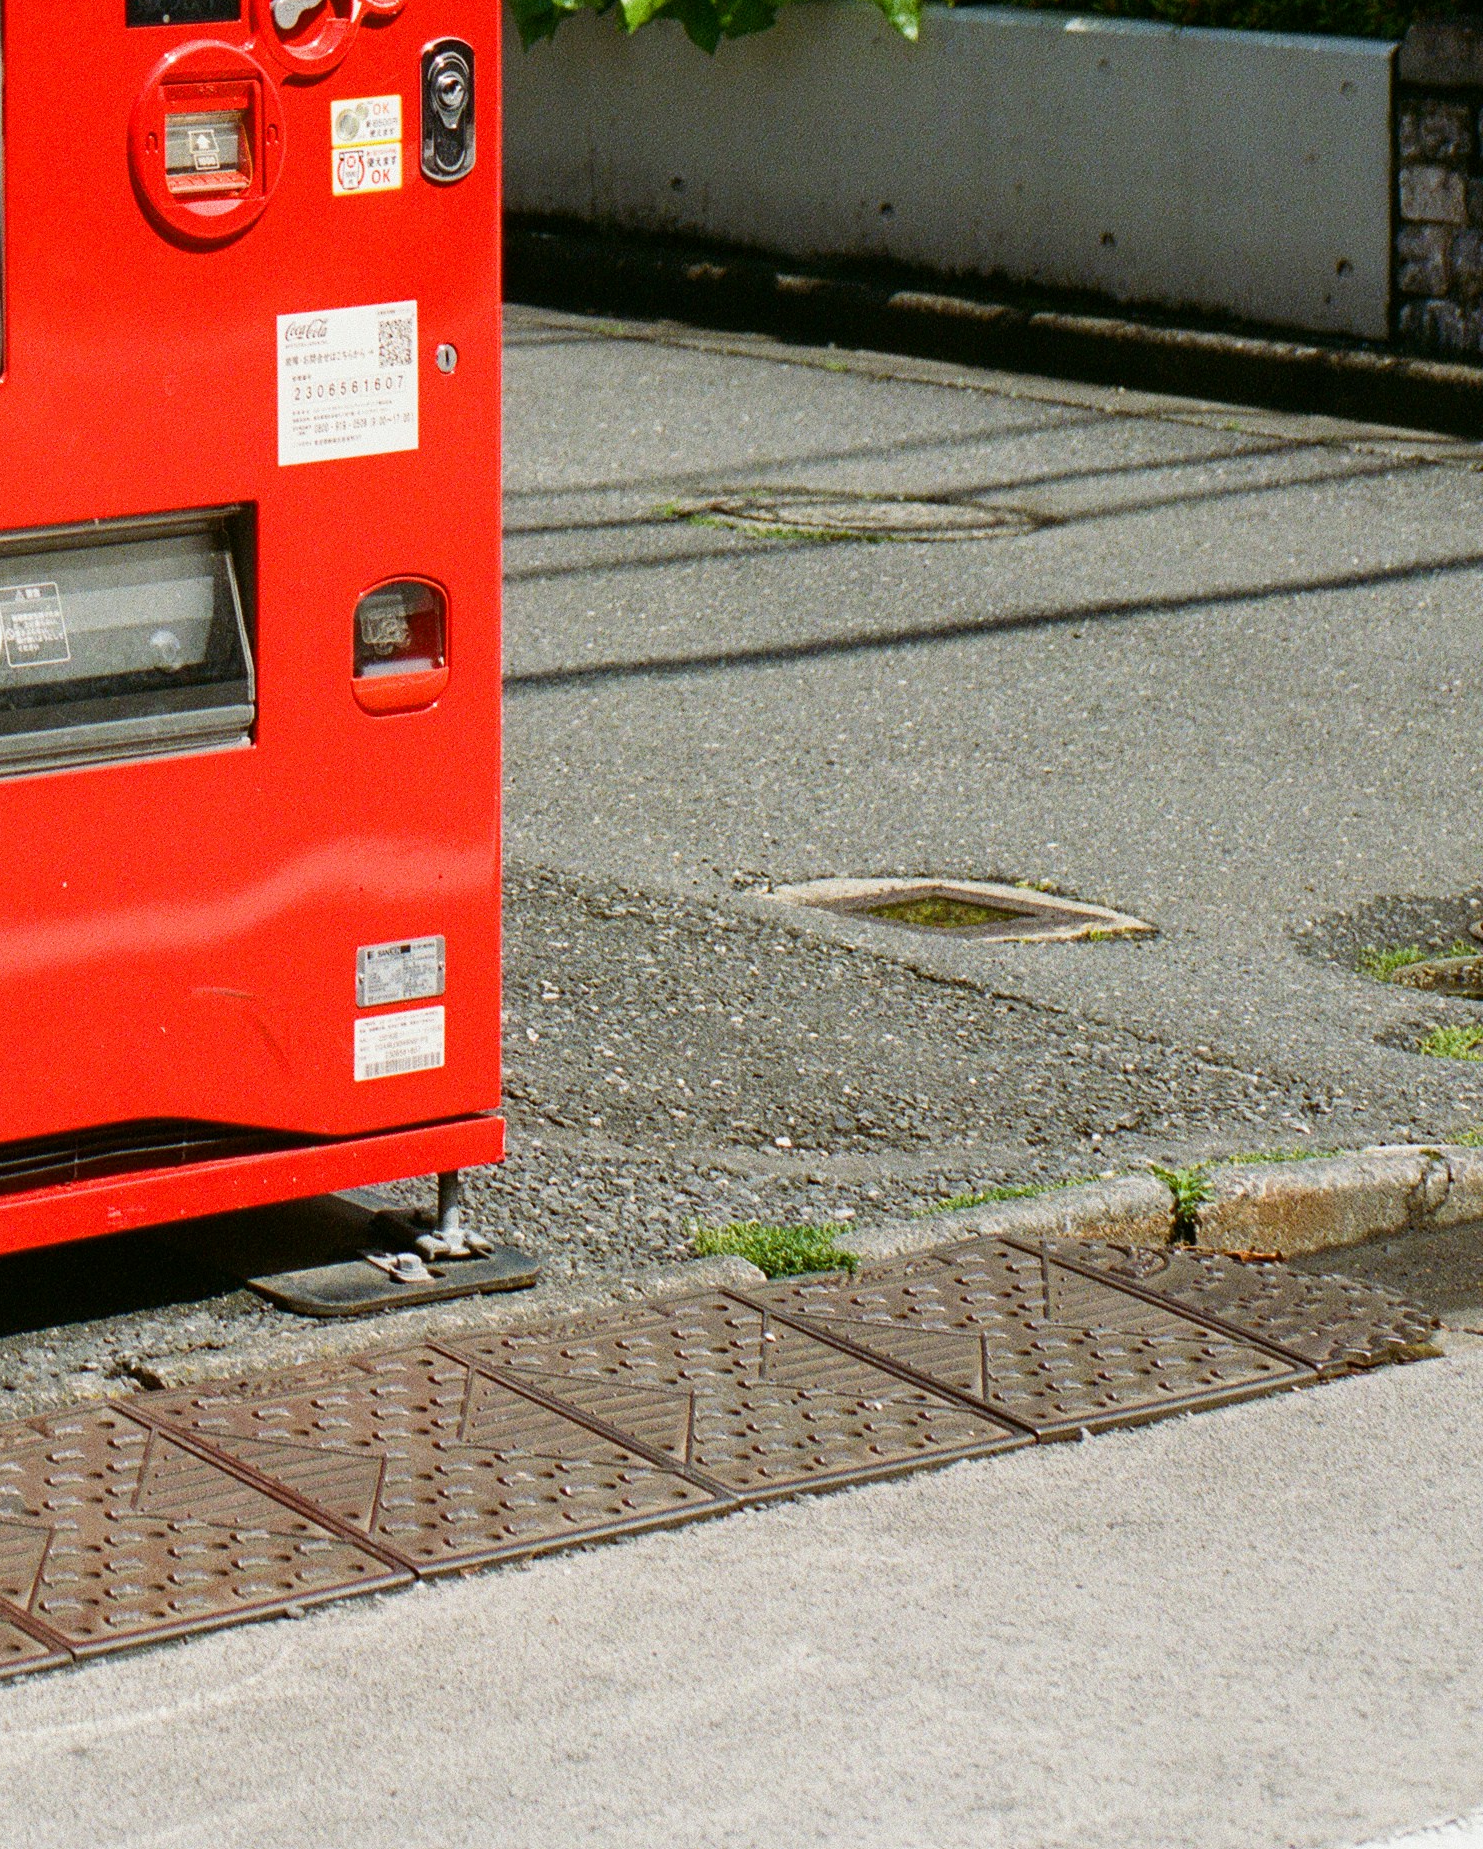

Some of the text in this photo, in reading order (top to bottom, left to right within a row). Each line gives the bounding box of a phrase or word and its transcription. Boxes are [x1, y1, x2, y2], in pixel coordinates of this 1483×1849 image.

[372, 102, 391, 116] OK
[370, 169, 392, 185] OK
[284, 318, 329, 343] Coca-Cola
